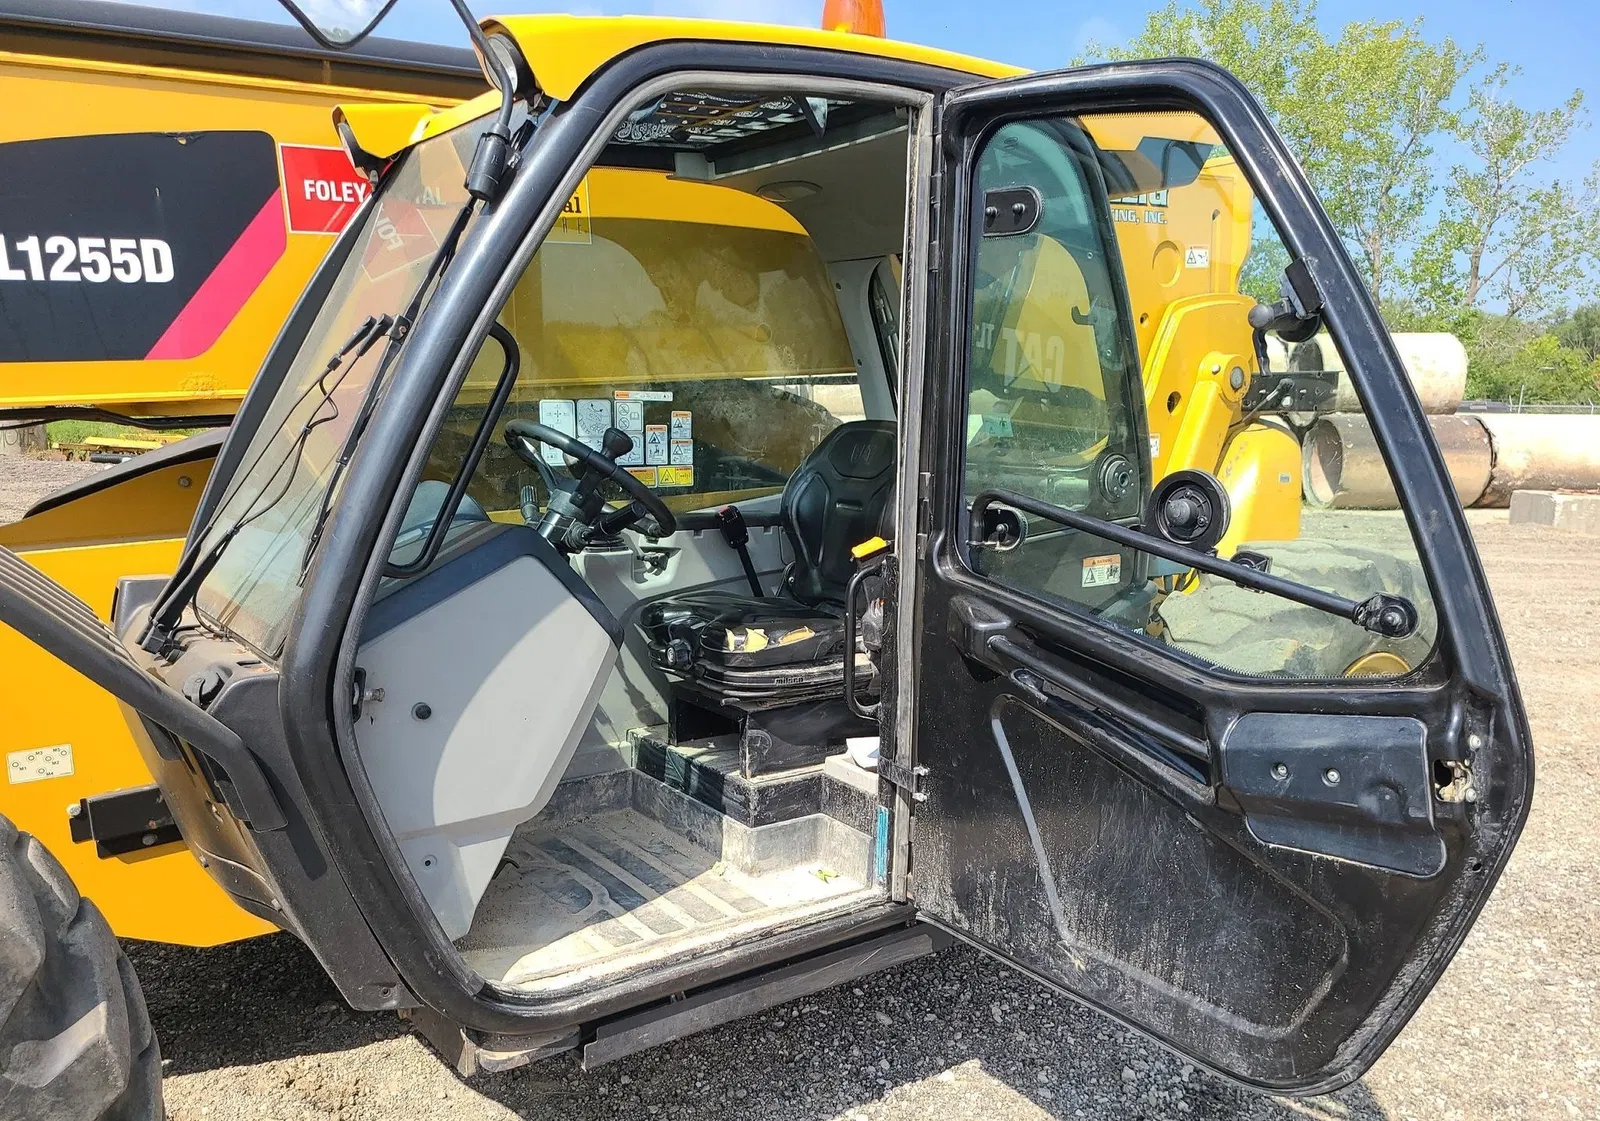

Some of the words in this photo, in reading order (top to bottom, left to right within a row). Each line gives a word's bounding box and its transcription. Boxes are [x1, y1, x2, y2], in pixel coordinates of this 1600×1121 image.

[303, 179, 367, 203] FOLEY
[1144, 210, 1169, 225] INC.
[0, 233, 175, 283] L1255D
